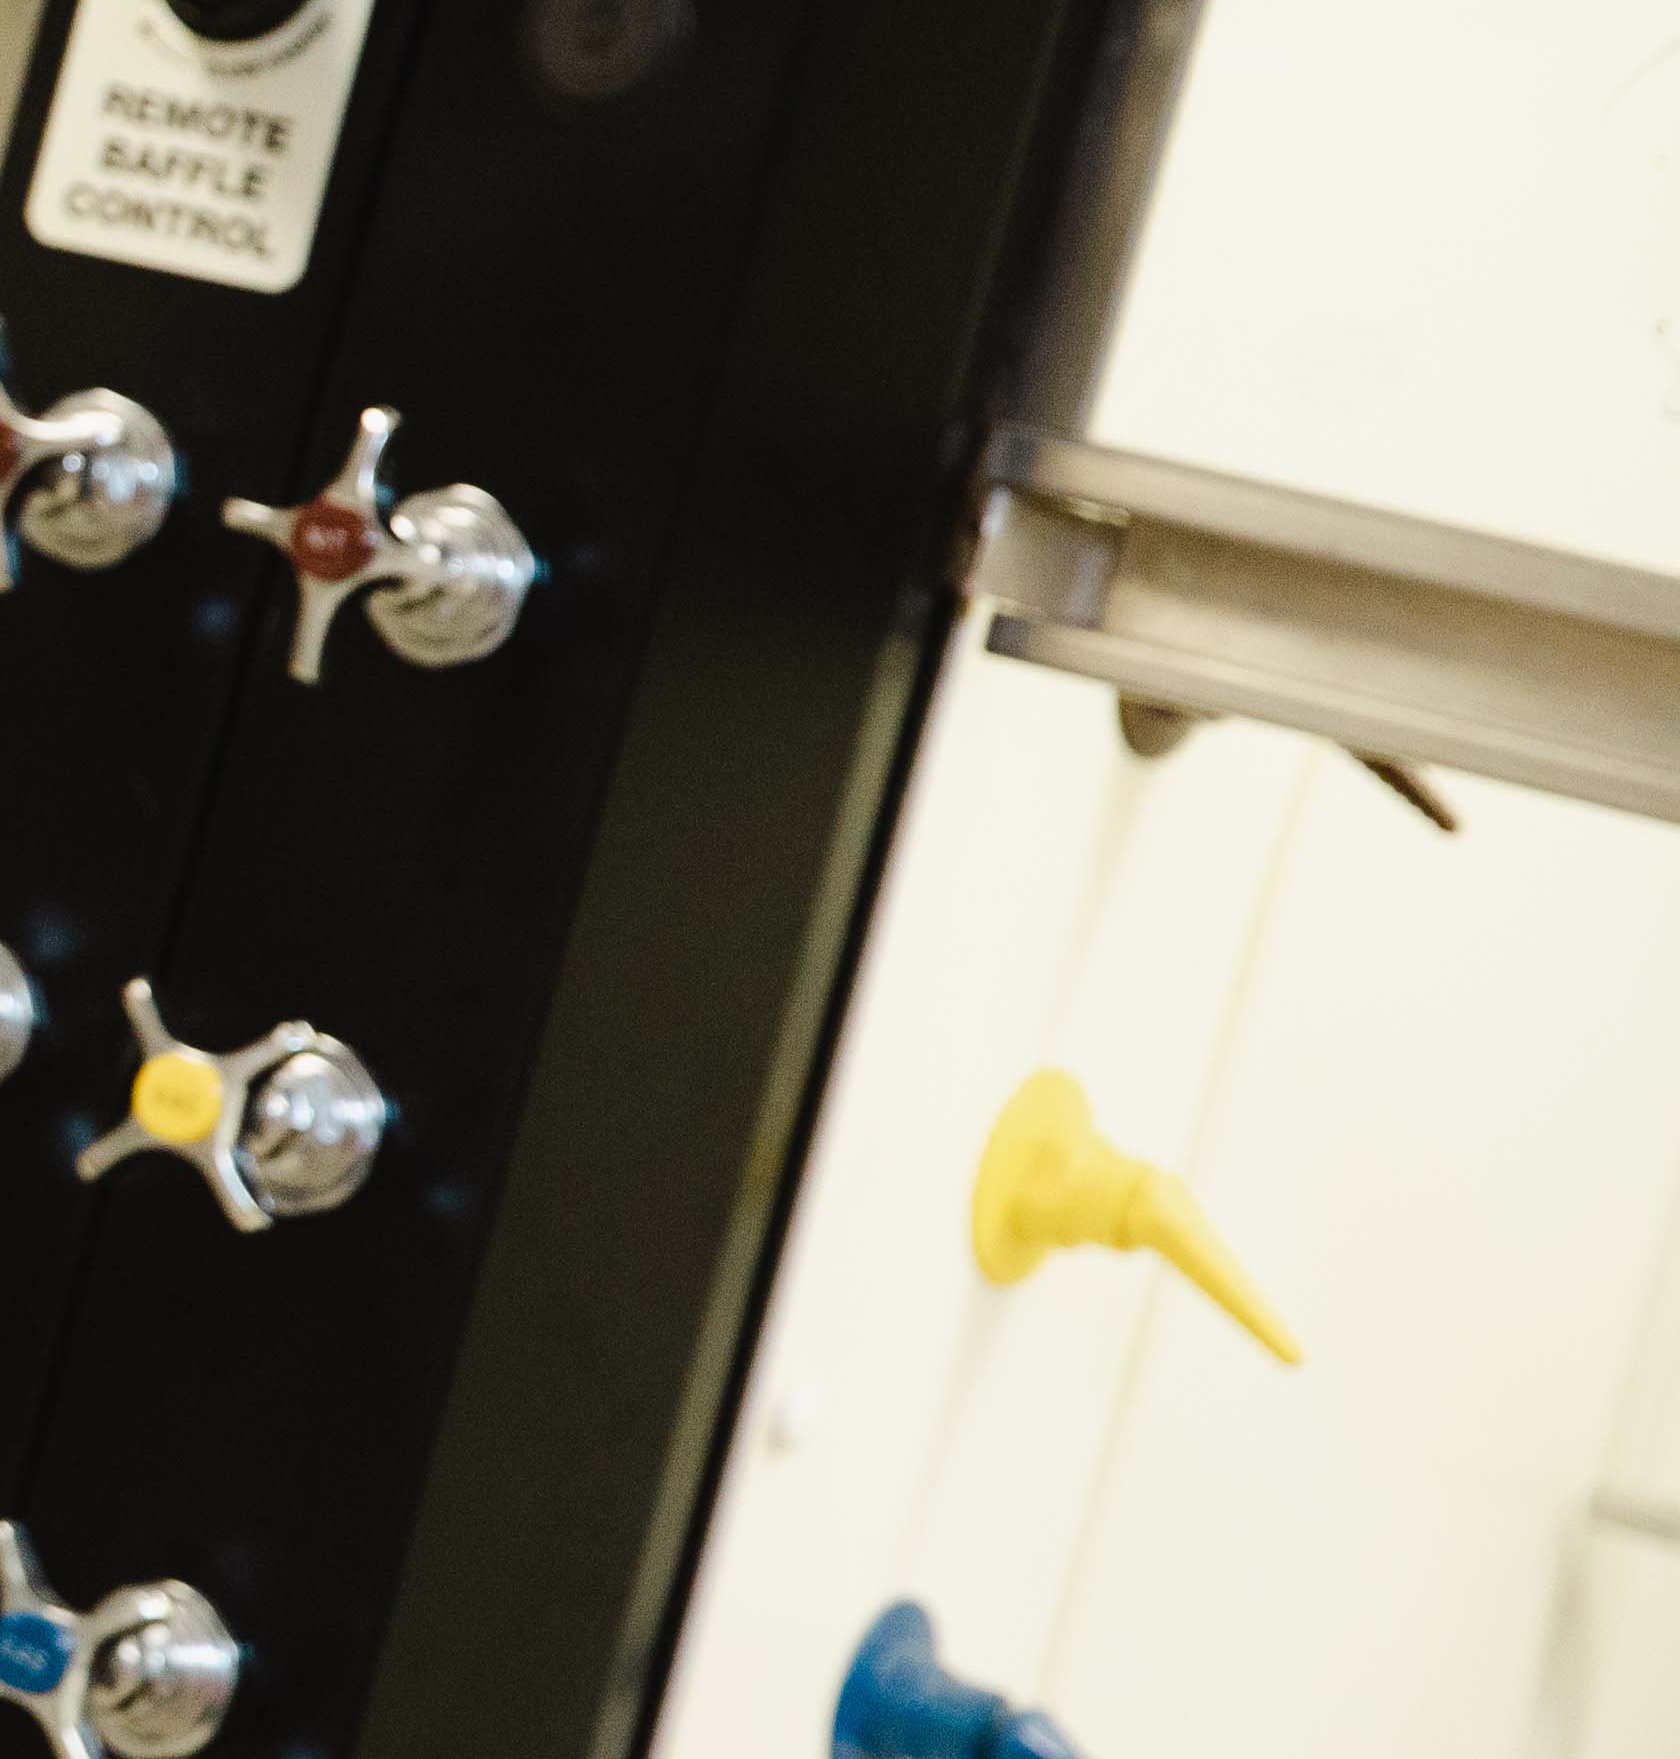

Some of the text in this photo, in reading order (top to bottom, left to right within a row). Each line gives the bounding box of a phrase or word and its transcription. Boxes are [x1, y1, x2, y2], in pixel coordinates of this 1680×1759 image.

[103, 82, 295, 156] REMOTE
[98, 140, 272, 202] BAFFLE
[62, 182, 274, 263] CONTROL
